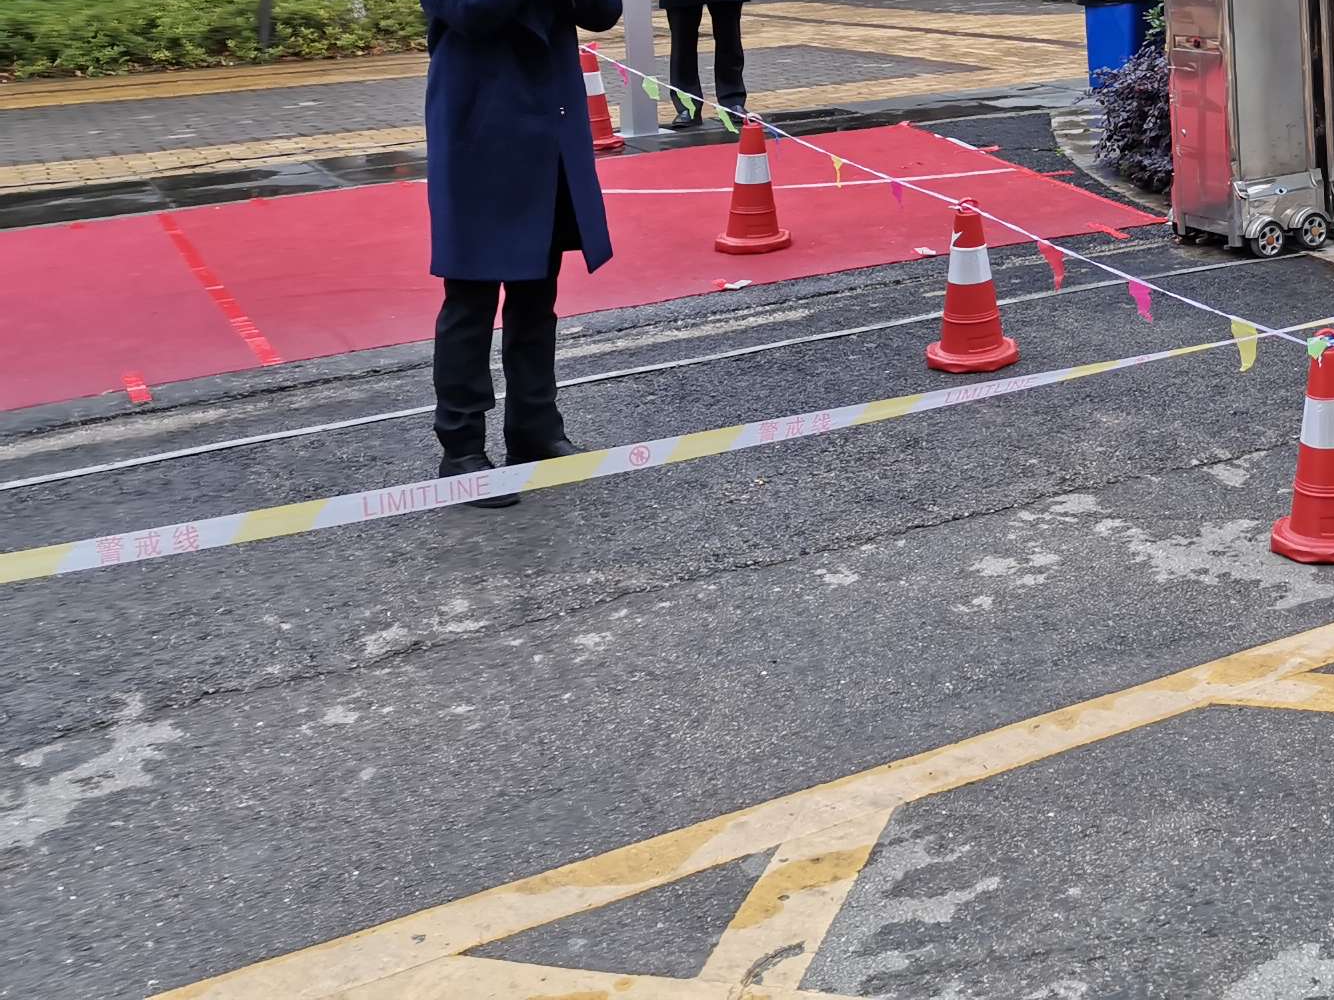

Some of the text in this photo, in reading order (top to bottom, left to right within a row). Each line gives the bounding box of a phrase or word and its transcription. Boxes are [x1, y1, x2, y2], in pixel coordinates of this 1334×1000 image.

[758, 413, 832, 442] 警戒线
[361, 475, 491, 520] LIMITLINE
[95, 525, 201, 565] 警戒线
